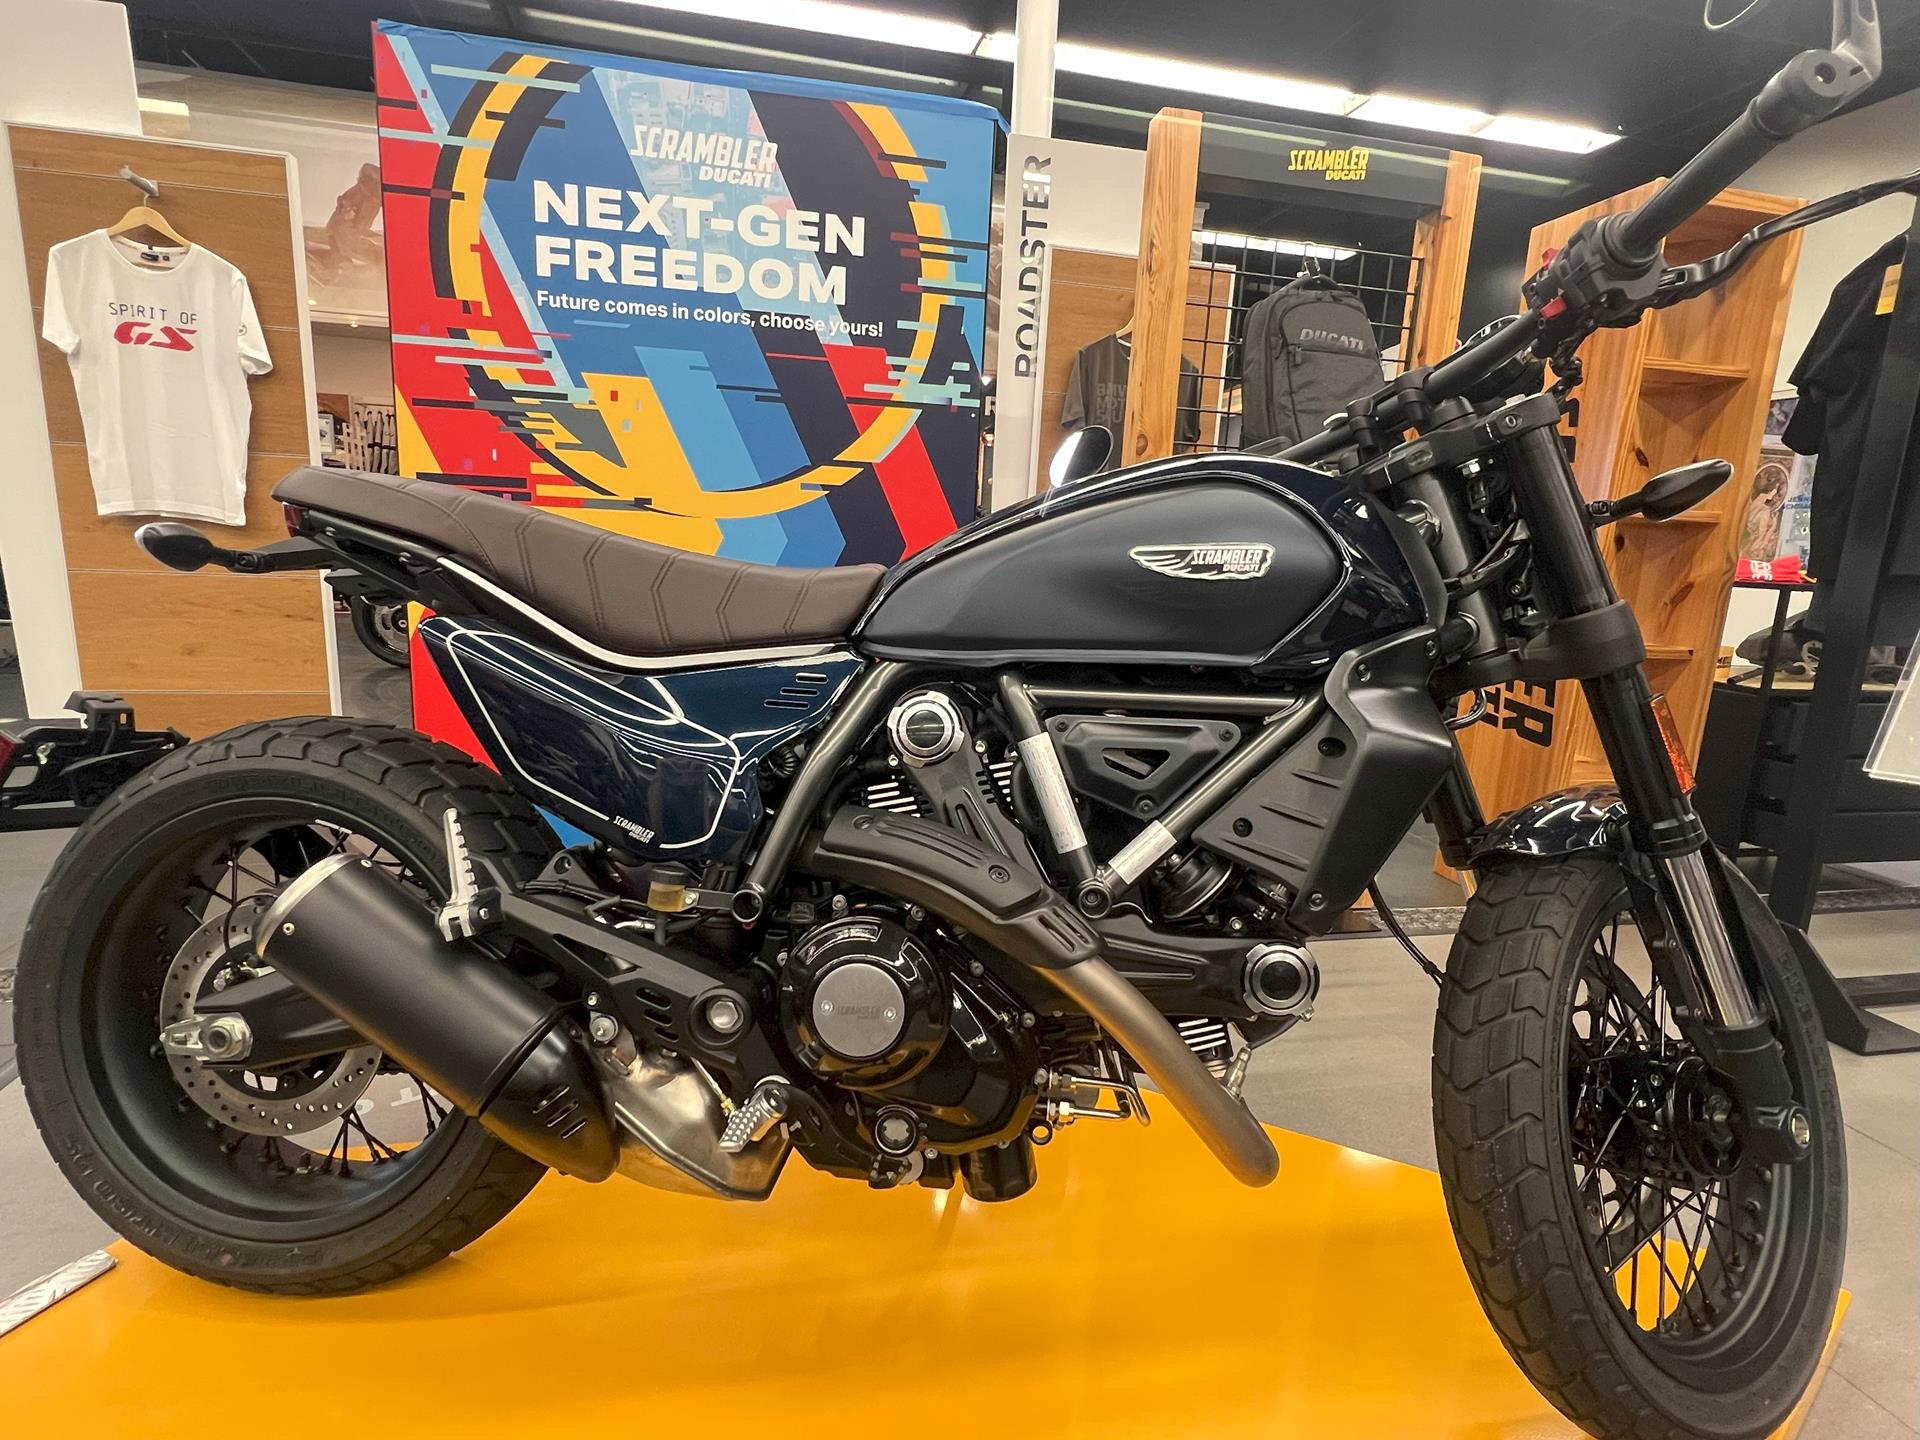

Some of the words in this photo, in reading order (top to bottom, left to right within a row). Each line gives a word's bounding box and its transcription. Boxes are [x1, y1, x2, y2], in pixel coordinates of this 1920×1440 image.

[630, 125, 778, 172] SCRAMBLER
[1287, 148, 1370, 172] SCRAMBLER
[699, 166, 773, 188] DUCATI
[1325, 170, 1367, 181] DUCATI
[533, 179, 866, 257] NEXT-GEN
[535, 235, 847, 306] FREEDOM
[1014, 155, 1051, 378] ROADSTER
[108, 302, 168, 321] SPIRIT
[179, 311, 198, 325] OF
[537, 290, 600, 312] Future
[605, 299, 668, 319] comes
[672, 302, 690, 319] in
[693, 307, 756, 328] colors,
[760, 310, 825, 332] choose
[828, 319, 884, 338] yours!
[114, 321, 198, 352] GS
[1299, 327, 1364, 352] DUCATI
[1191, 549, 1263, 565] SCRAMBLER
[1222, 564, 1260, 572] DUCATI
[613, 815, 655, 840] SCRAMBLER
